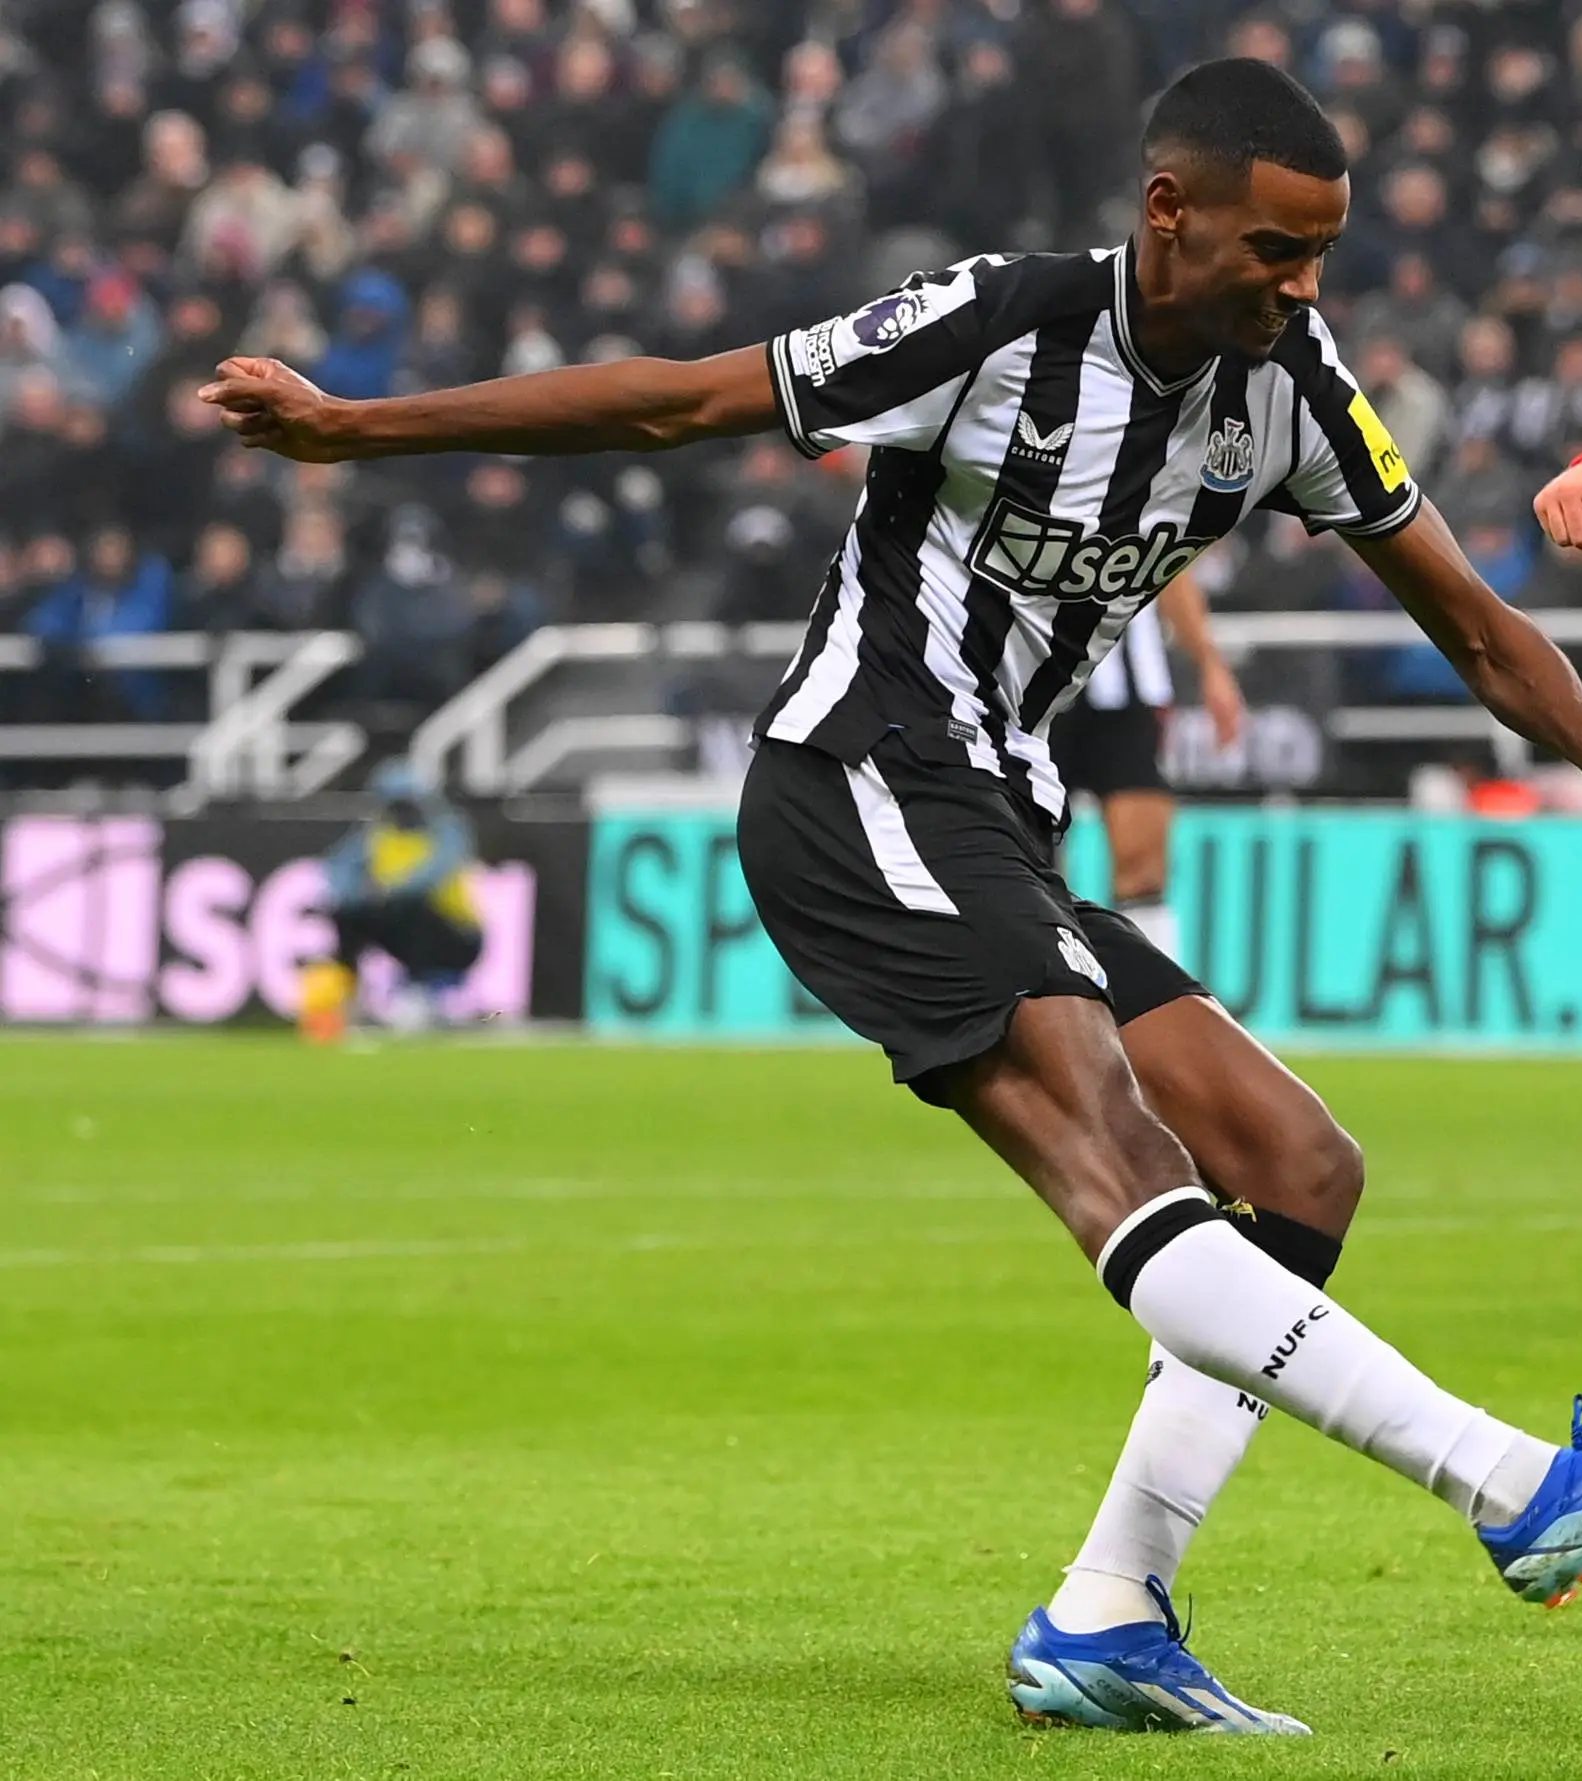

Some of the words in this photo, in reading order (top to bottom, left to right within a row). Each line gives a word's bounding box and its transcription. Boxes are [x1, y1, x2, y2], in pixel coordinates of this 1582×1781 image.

[1011, 446, 1062, 465] CASTORE
[612, 832, 1578, 1029] SPULAR.
[1261, 1304, 1330, 1380] NUFC
